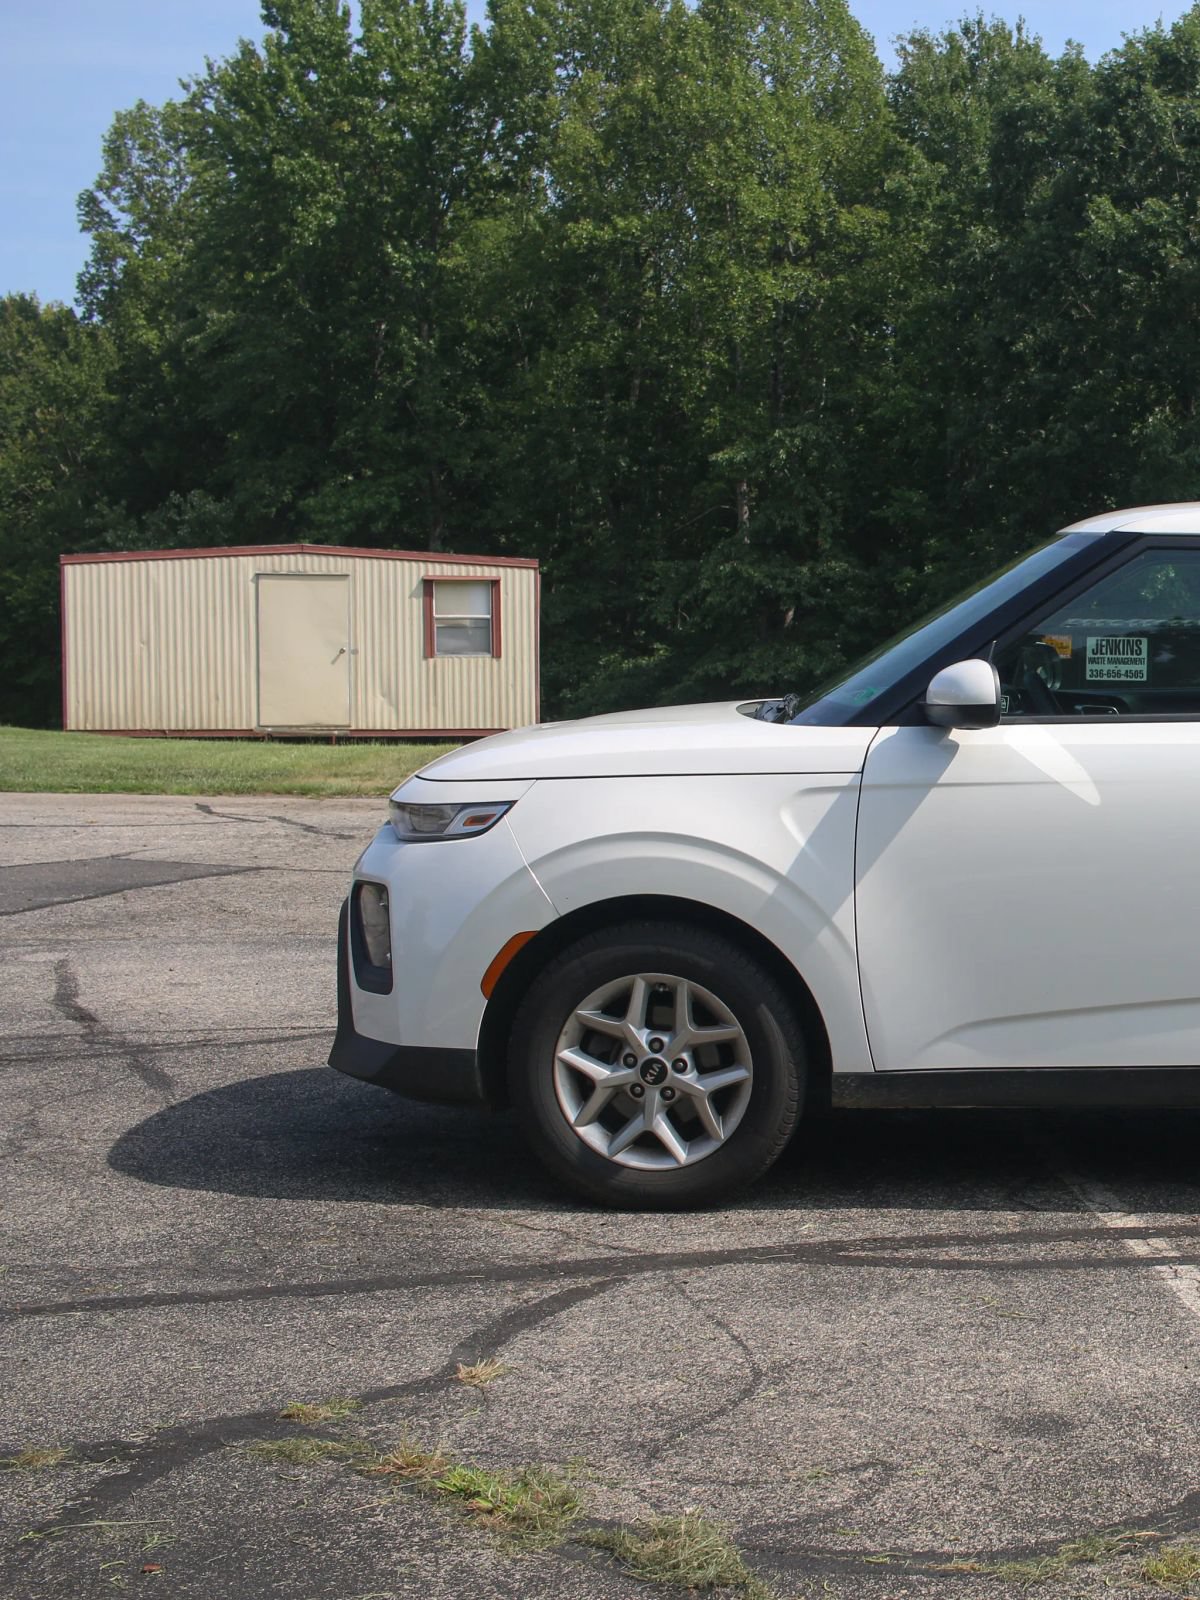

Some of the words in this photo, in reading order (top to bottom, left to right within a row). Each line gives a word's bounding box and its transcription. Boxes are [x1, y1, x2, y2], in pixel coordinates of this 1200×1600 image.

[1091, 638, 1143, 656] JENKINS
[1088, 657, 1106, 665] WASTE
[1107, 657, 1146, 666] MANAGEMENT
[1088, 669, 1144, 679] 336-656-4505
[644, 1063, 662, 1083] KIA
